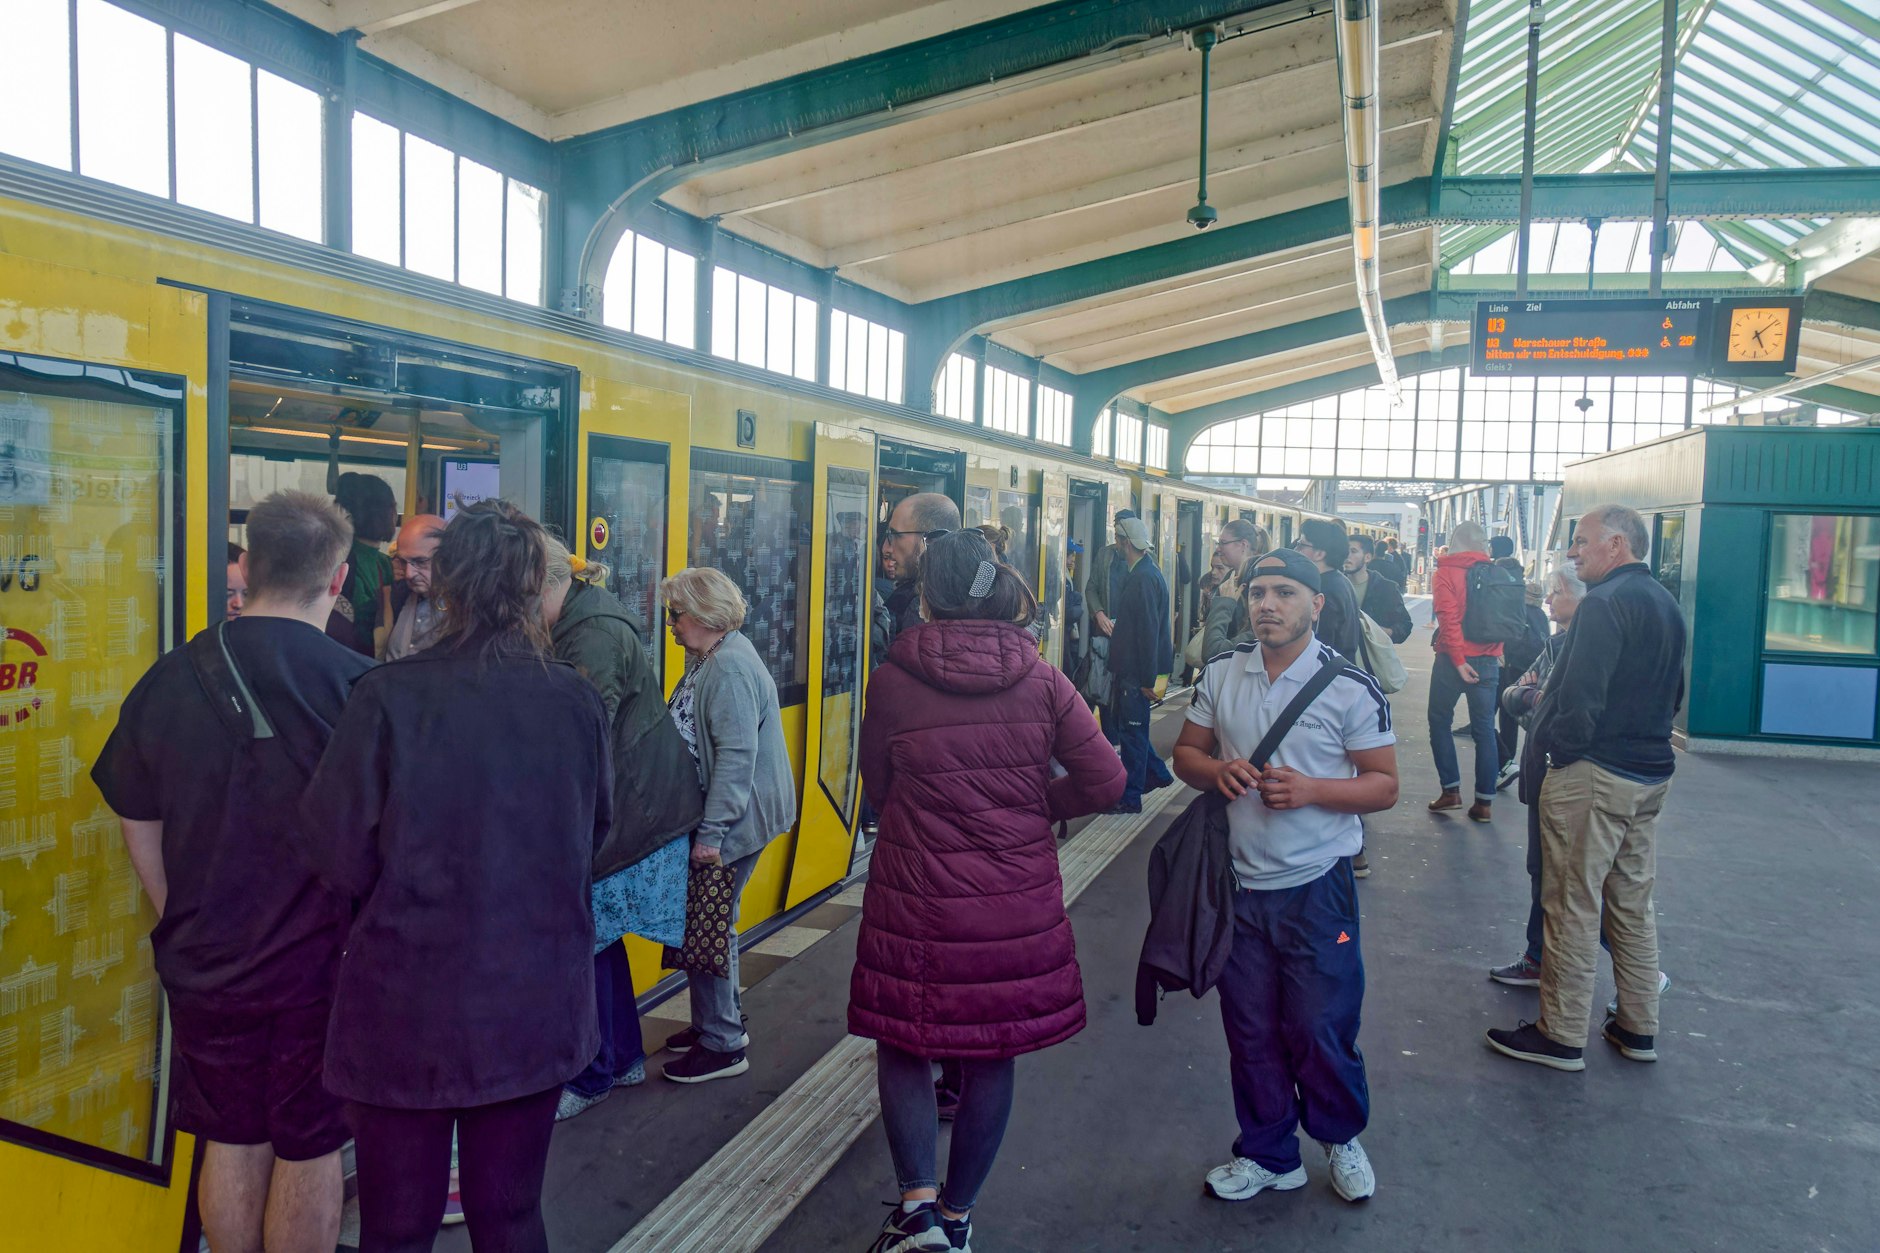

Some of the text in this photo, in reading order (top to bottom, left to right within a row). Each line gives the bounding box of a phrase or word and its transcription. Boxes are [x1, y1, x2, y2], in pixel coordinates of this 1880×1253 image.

[1488, 301, 1701, 313] Linie Ziel Abfahrt
[1487, 317, 1506, 333] U3
[1486, 338, 1499, 348] U3
[1513, 337, 1571, 348] Warschauer
[1572, 336, 1607, 349] Straße
[1486, 349, 1515, 360] bitten
[1516, 349, 1531, 360] wir
[1485, 363, 1513, 372] Gleis 2
